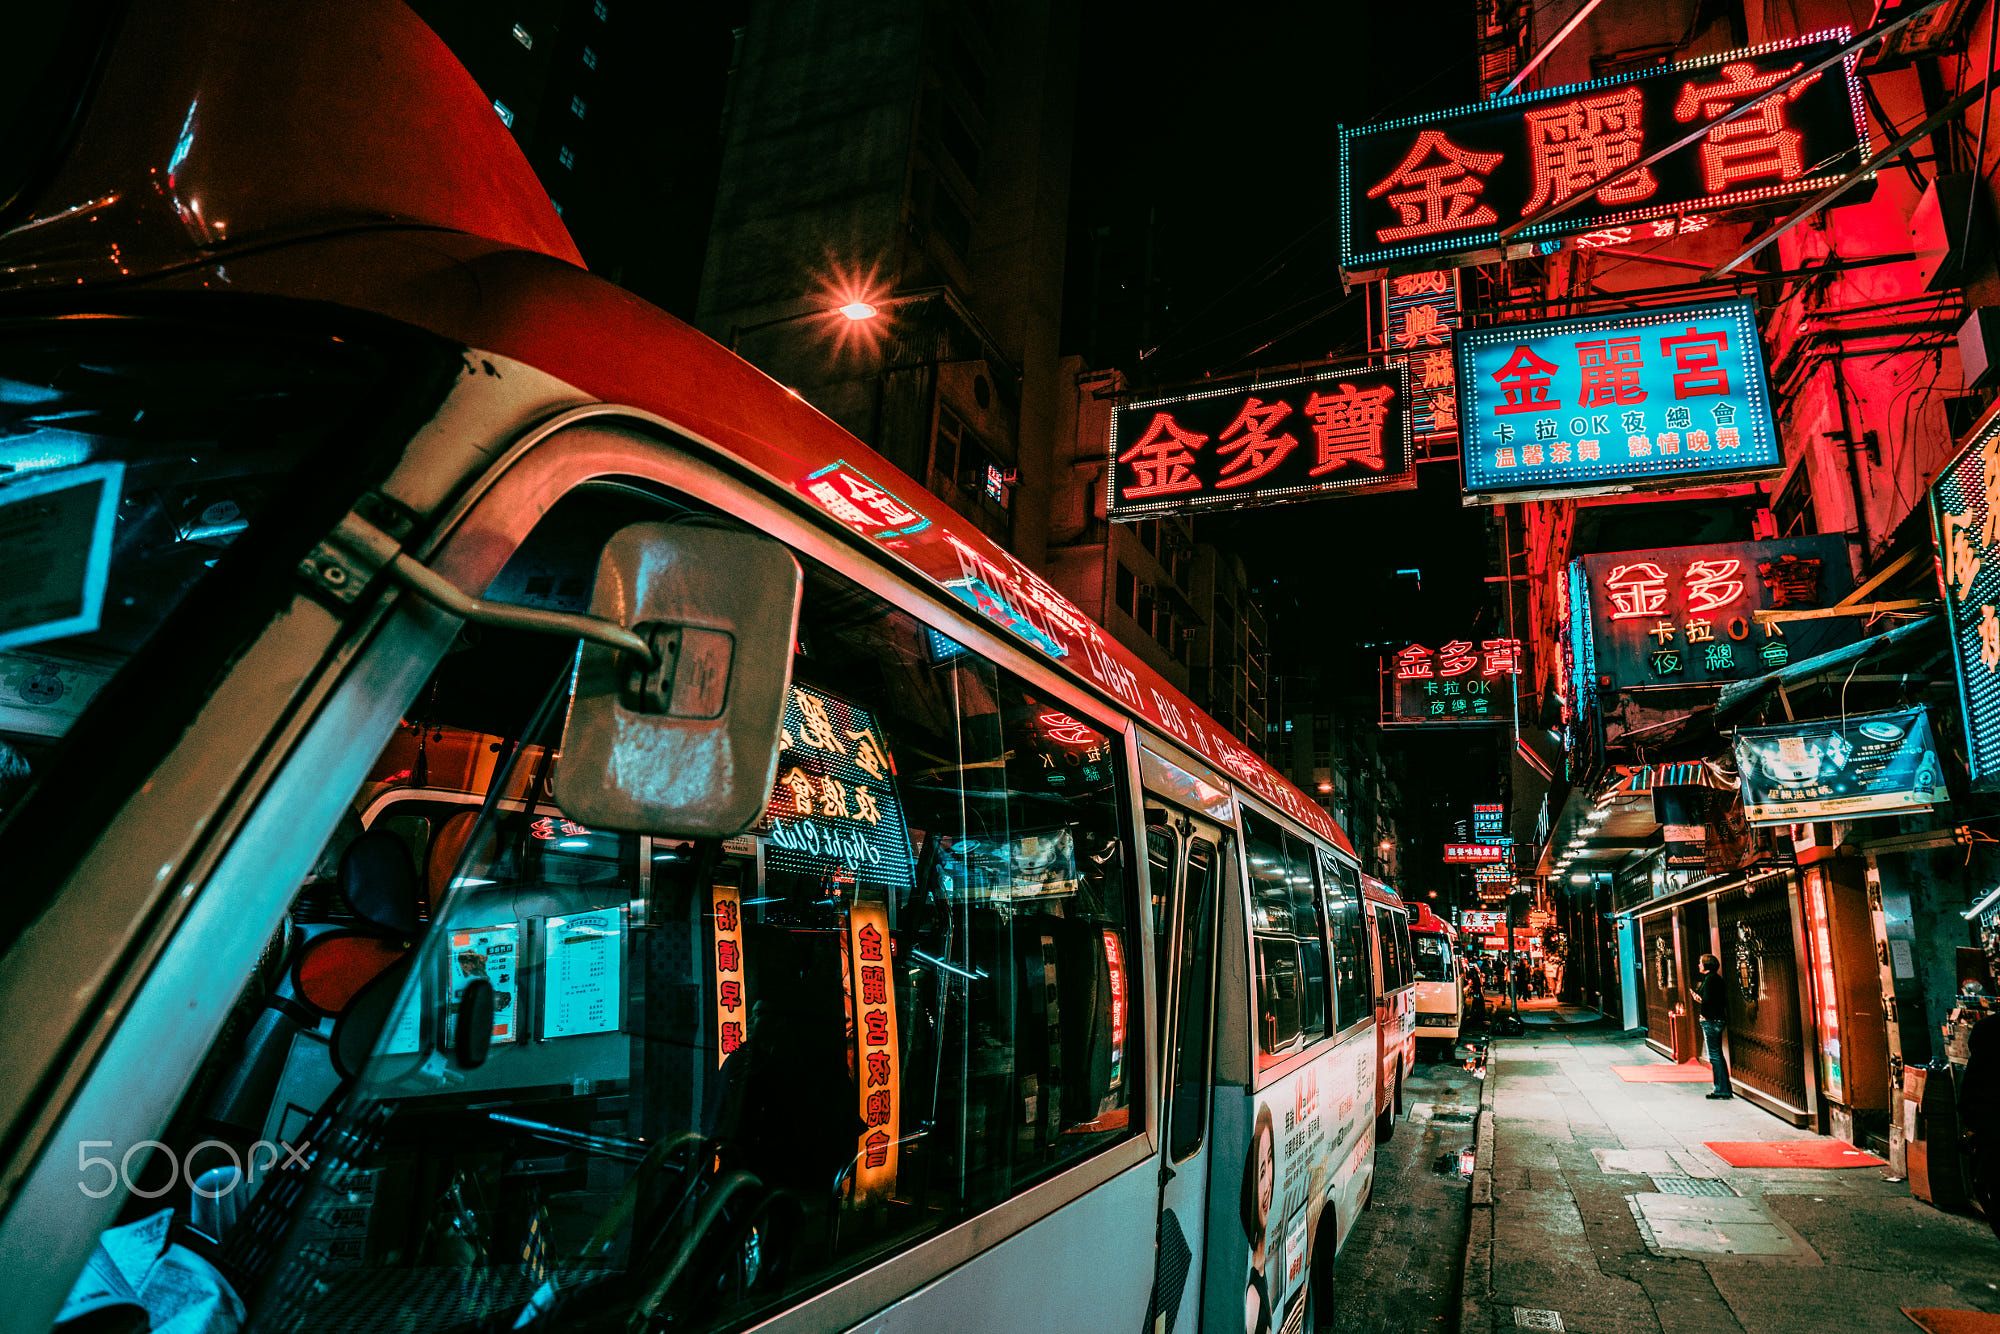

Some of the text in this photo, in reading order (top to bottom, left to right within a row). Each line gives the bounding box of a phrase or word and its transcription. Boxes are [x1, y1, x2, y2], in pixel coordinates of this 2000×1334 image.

[1367, 62, 1823, 243] 金麗宮
[1491, 327, 1731, 417] 金麗宮
[1118, 383, 1395, 499] 金多寶
[953, 540, 1069, 656] PUBLIC
[1080, 633, 1144, 710] LIGHT
[1151, 687, 1188, 740] BUS
[1650, 615, 1783, 645] 卡拉OK
[1652, 642, 1789, 675] 夜總會
[1424, 680, 1491, 696] 卡拉OK
